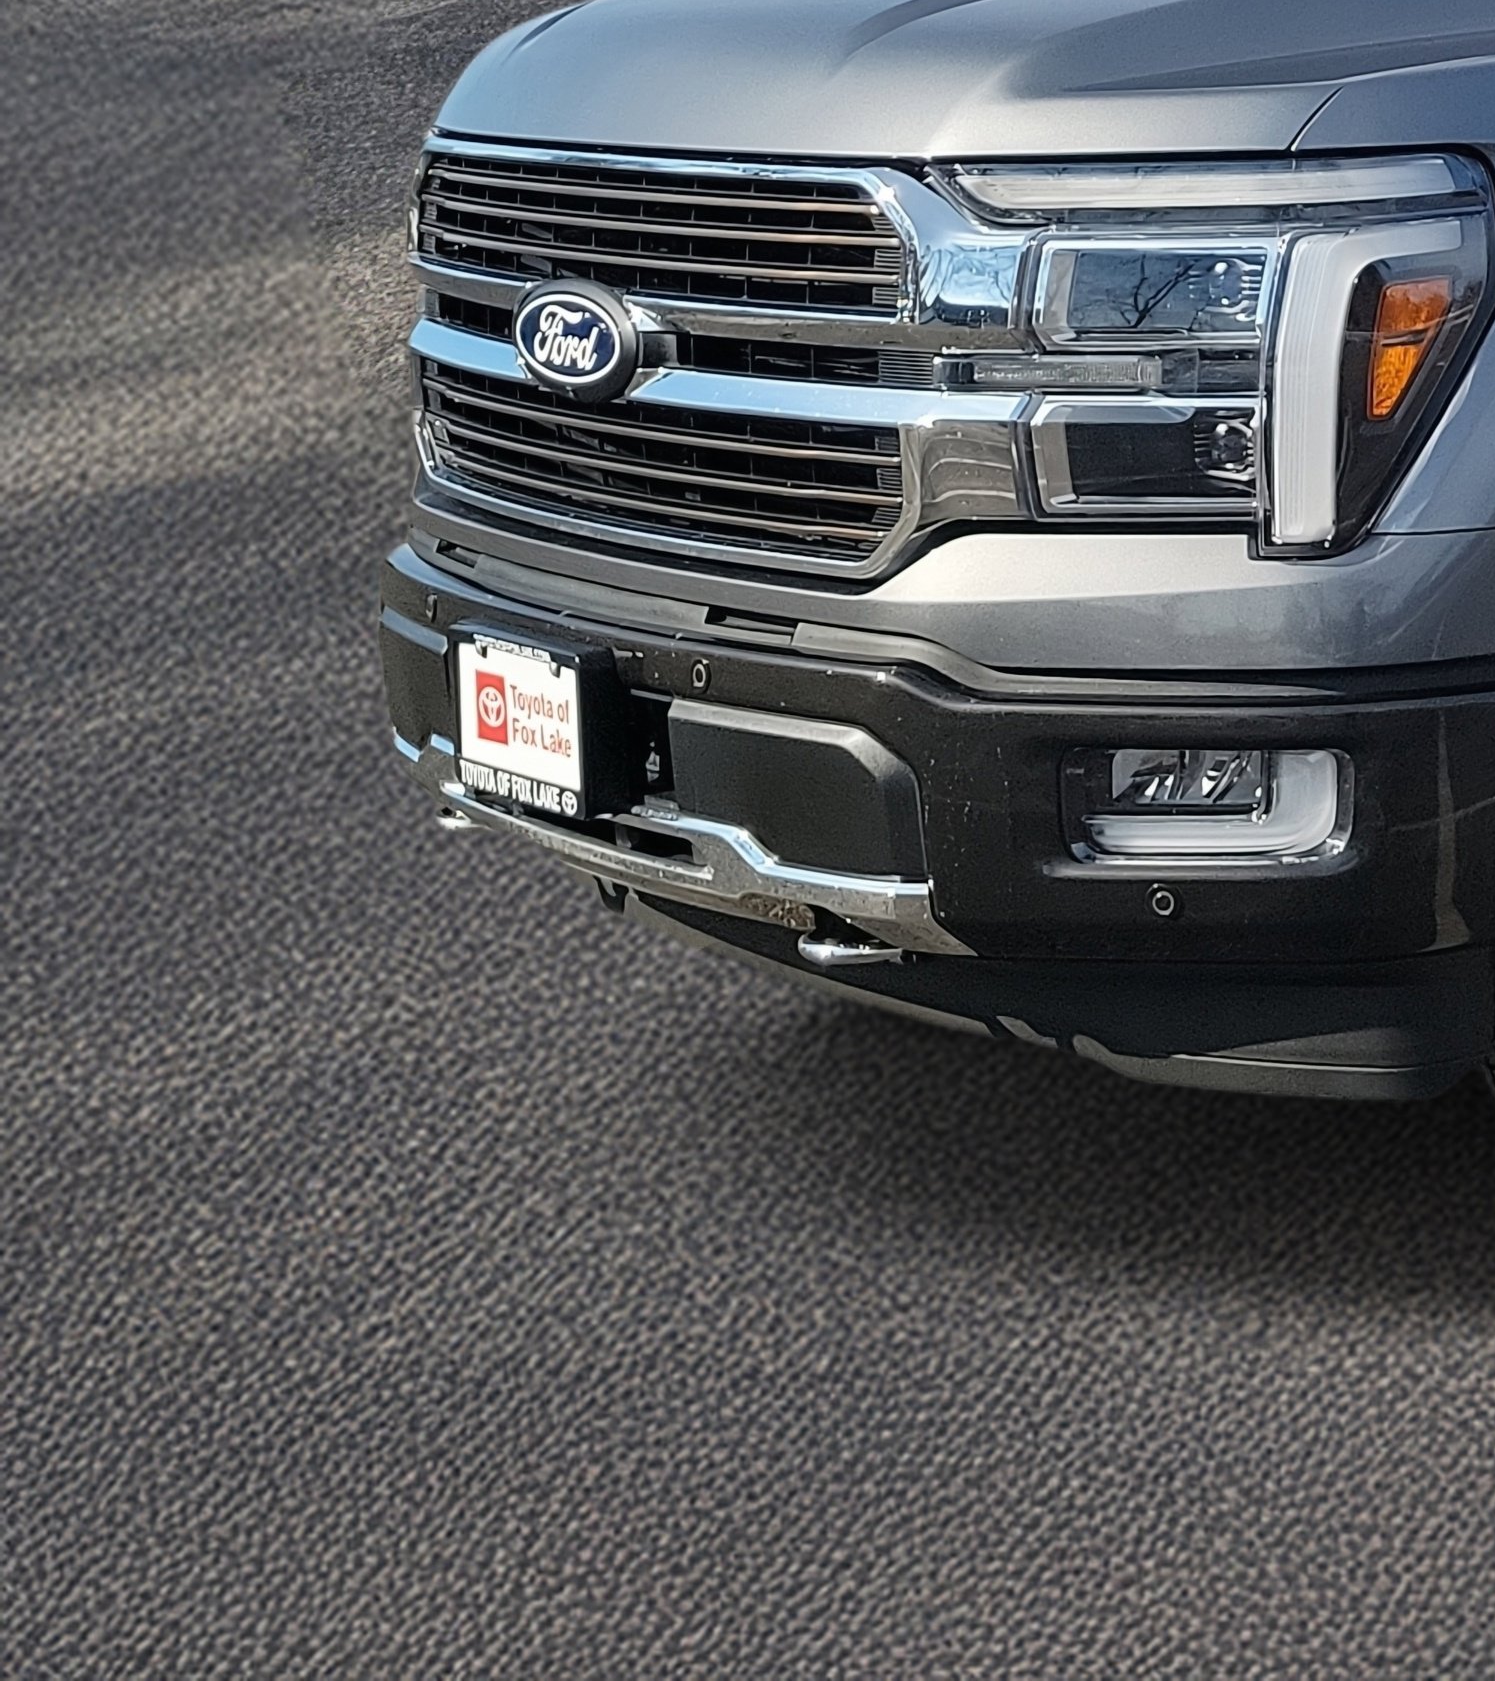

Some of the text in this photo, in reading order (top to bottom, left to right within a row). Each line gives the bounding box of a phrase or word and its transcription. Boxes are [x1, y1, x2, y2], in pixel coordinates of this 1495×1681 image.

[533, 304, 600, 371] Ford
[510, 684, 570, 725] Toyota of
[512, 717, 572, 759] Fox Lake
[459, 759, 562, 814] TOYOTA OF FOX LAKE
